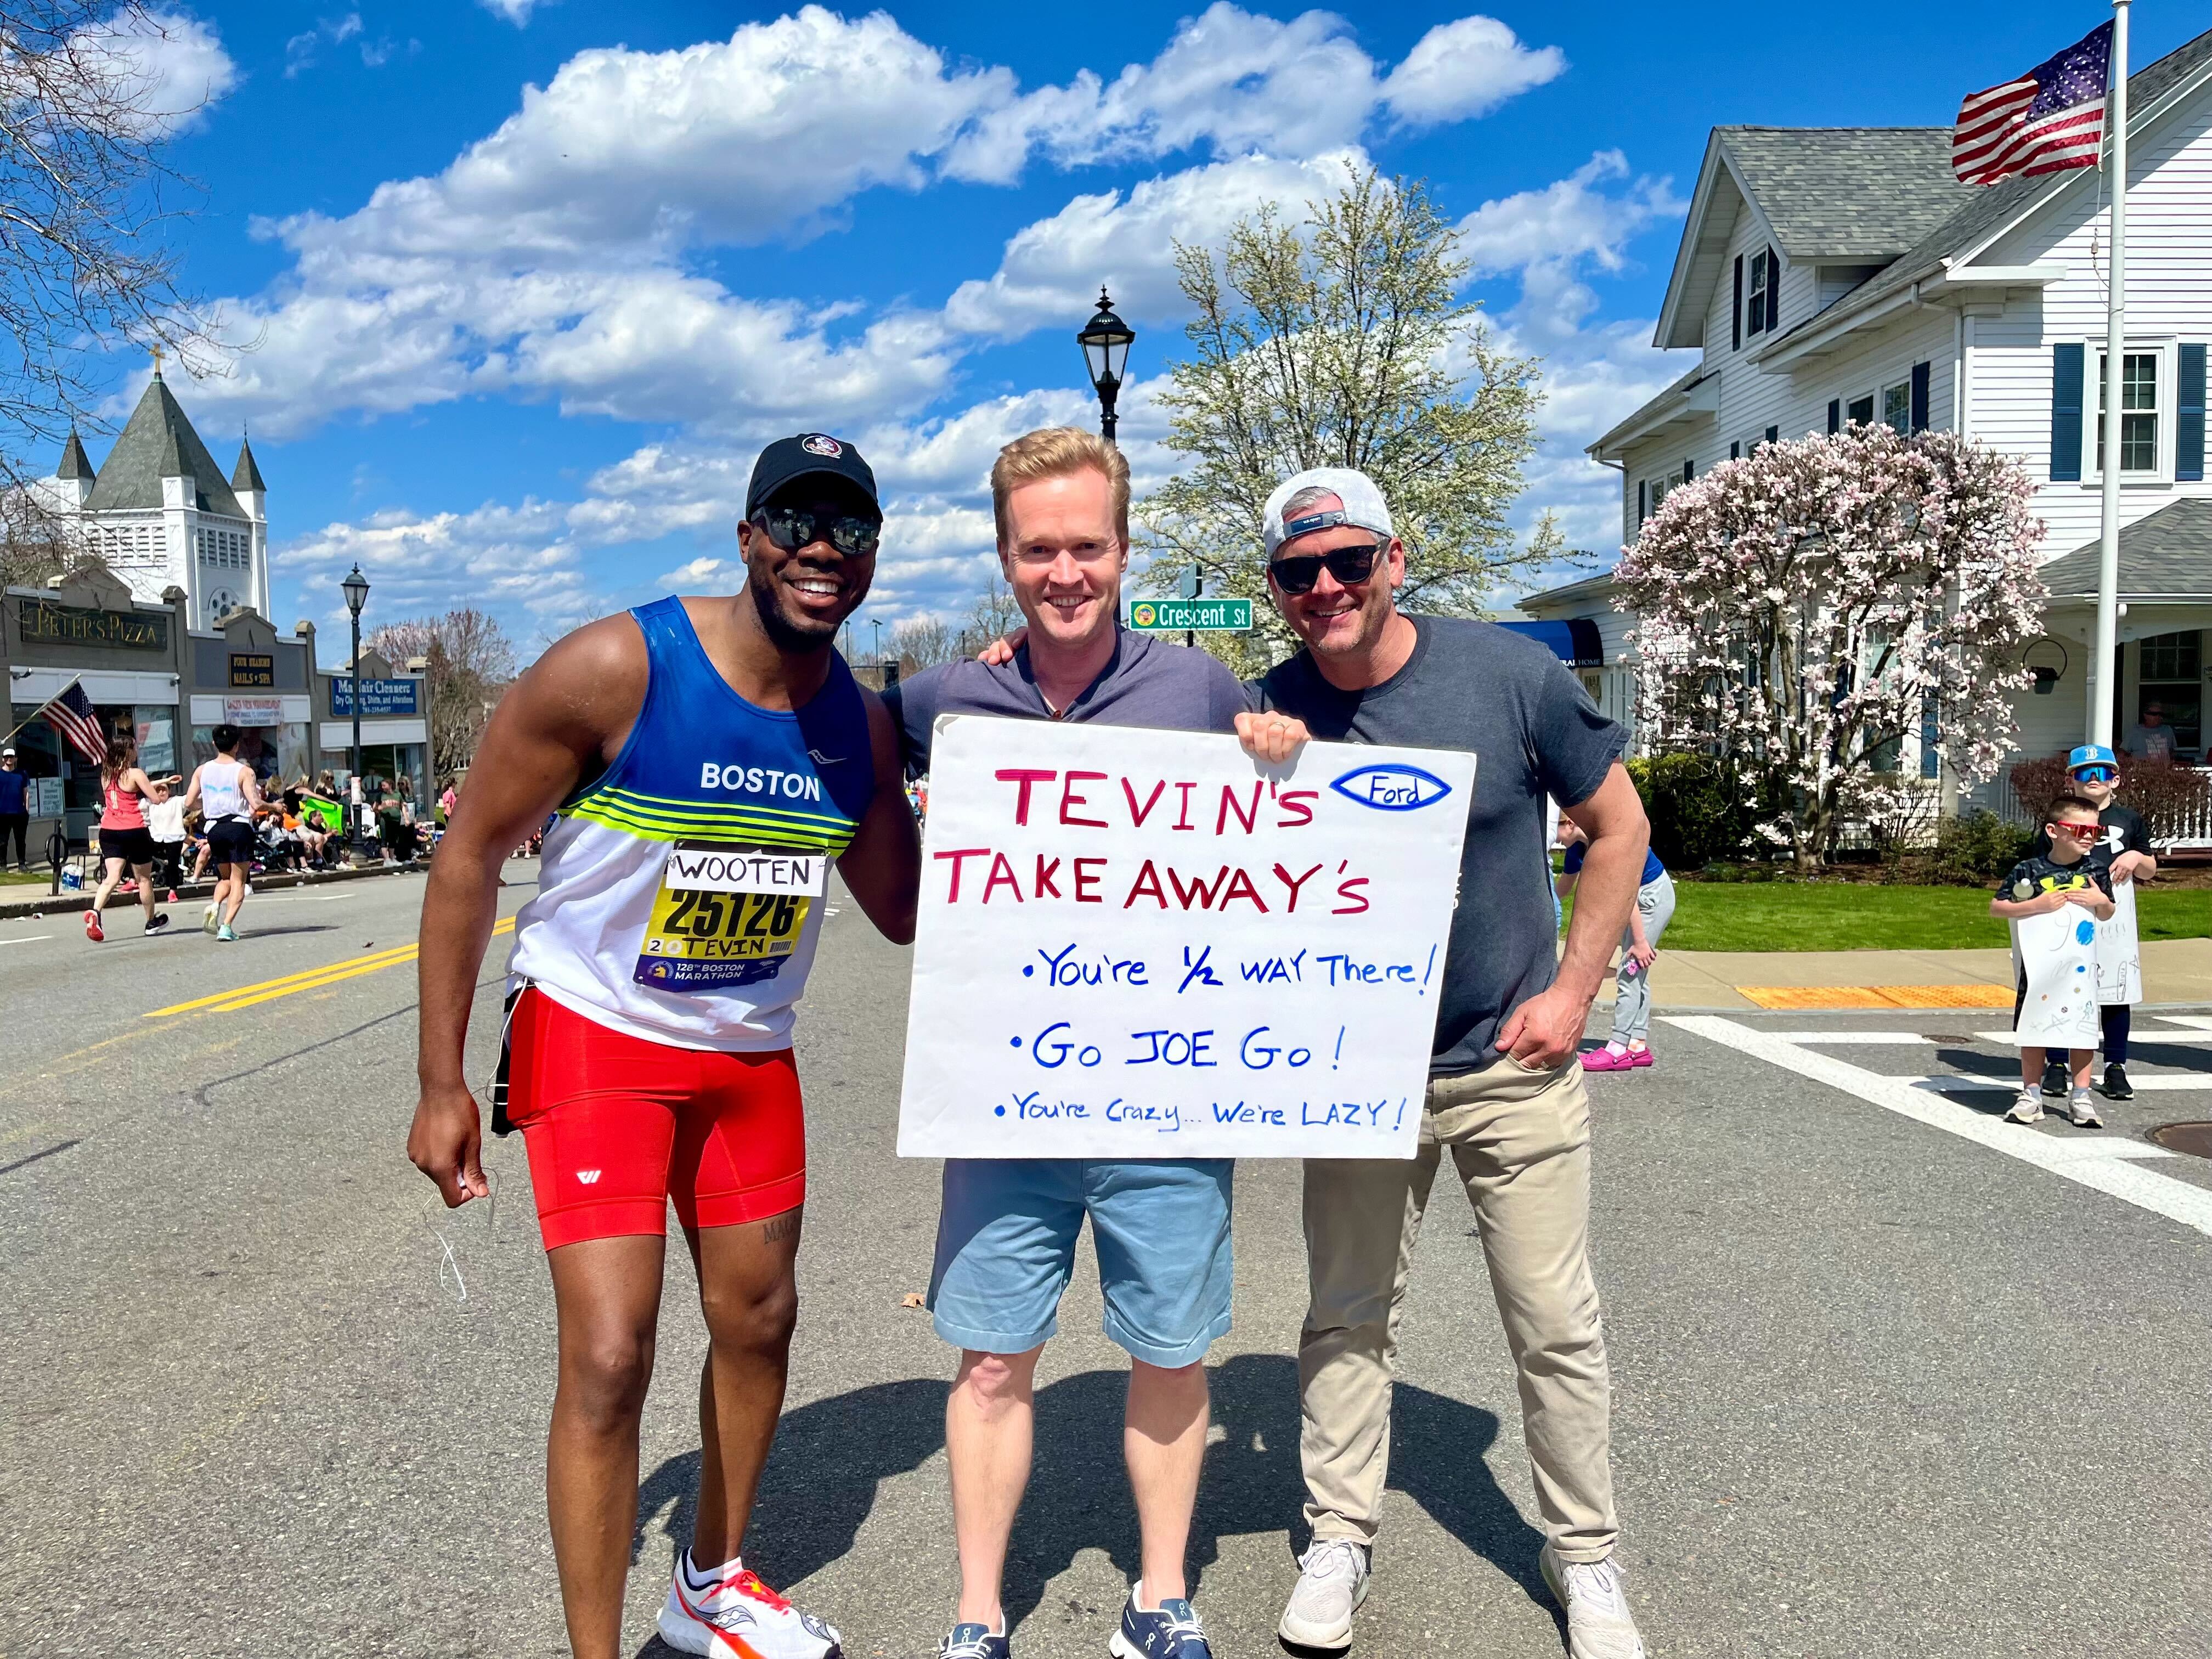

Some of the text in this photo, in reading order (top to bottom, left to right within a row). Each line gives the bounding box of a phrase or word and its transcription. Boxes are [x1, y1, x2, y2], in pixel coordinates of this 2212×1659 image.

[1159, 603, 1225, 626] Crescent
[1233, 607, 1246, 625] St
[110, 615, 157, 644] PIZZA
[234, 672, 271, 685] NAILS SPA
[337, 679, 410, 694] Mafair Cleaners
[335, 695, 345, 707] Dry
[701, 763, 821, 802] BOSTON
[1369, 775, 1421, 805] Ford
[676, 855, 810, 886] WOOTEN
[663, 889, 801, 937] 25126
[649, 940, 661, 952] 2
[682, 937, 765, 957] TEVIN
[674, 972, 742, 980] MARATHON
[702, 963, 745, 972] BOSTON
[1039, 944, 1149, 988] You're
[1241, 949, 1307, 984] WAY
[1032, 1022, 1102, 1069] Go
[1125, 1030, 1218, 1068] JOE
[1013, 1091, 1091, 1120] You're
[1212, 1101, 1286, 1126] We're
